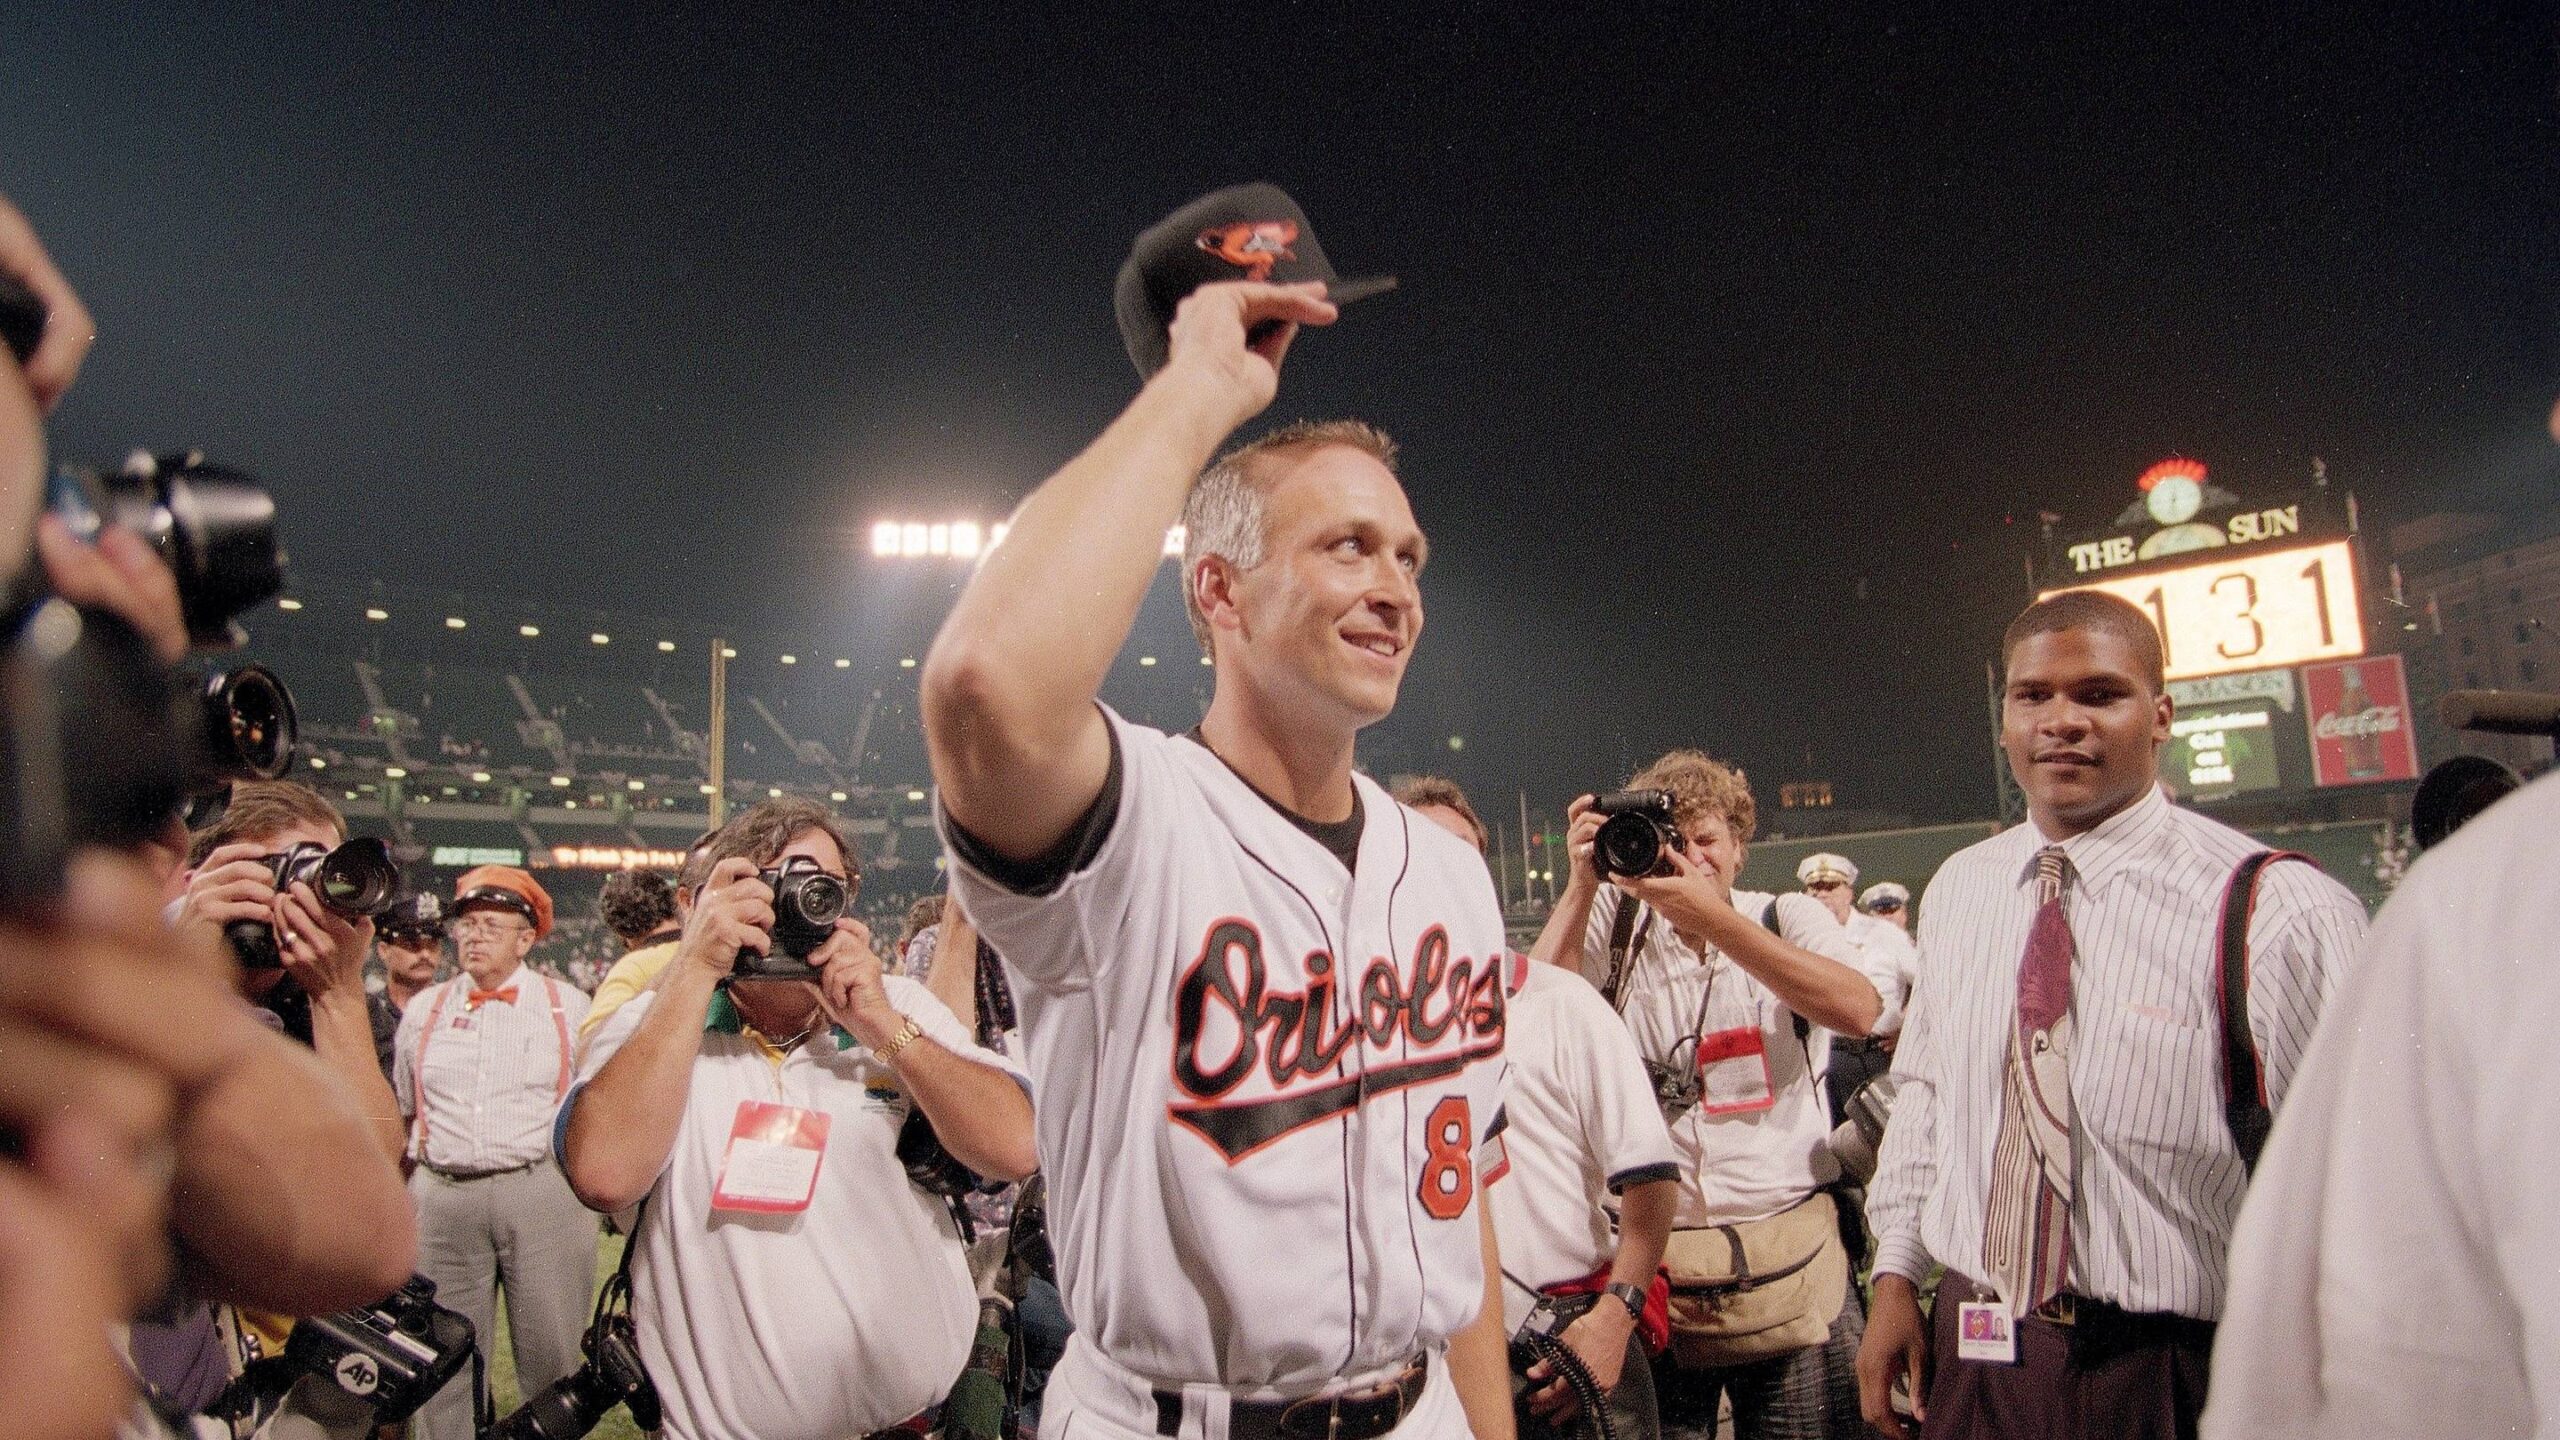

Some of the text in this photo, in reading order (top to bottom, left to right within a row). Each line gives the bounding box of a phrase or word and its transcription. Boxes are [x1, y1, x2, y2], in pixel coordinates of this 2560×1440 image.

[2068, 505, 2298, 573] THE SUN
[1172, 915, 1506, 1098] Orioles
[1416, 1095, 1473, 1220] 8
[341, 1362, 376, 1387] AP
